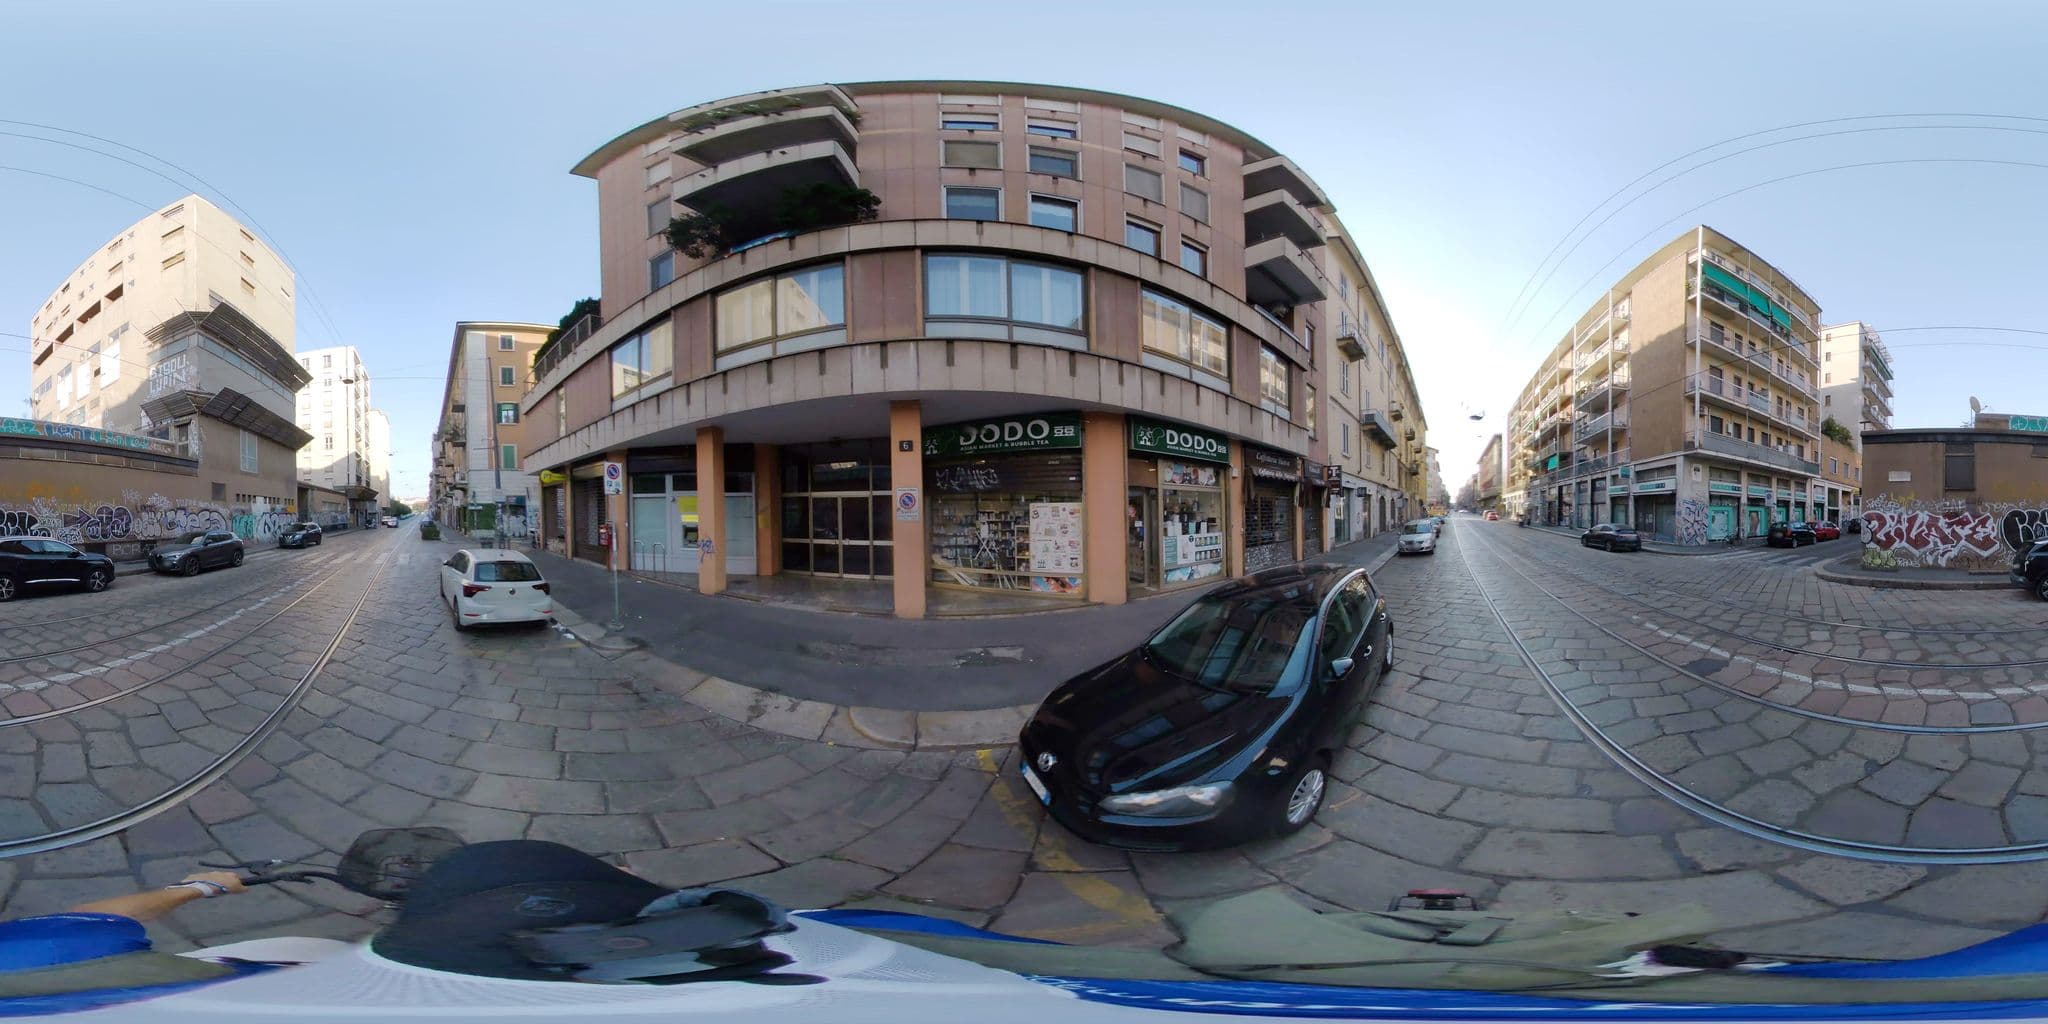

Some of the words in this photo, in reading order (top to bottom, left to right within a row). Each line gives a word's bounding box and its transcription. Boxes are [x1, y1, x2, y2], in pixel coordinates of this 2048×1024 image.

[960, 419, 1050, 446] DODO
[1166, 429, 1217, 453] DODO
[979, 442, 1003, 450] MARKET
